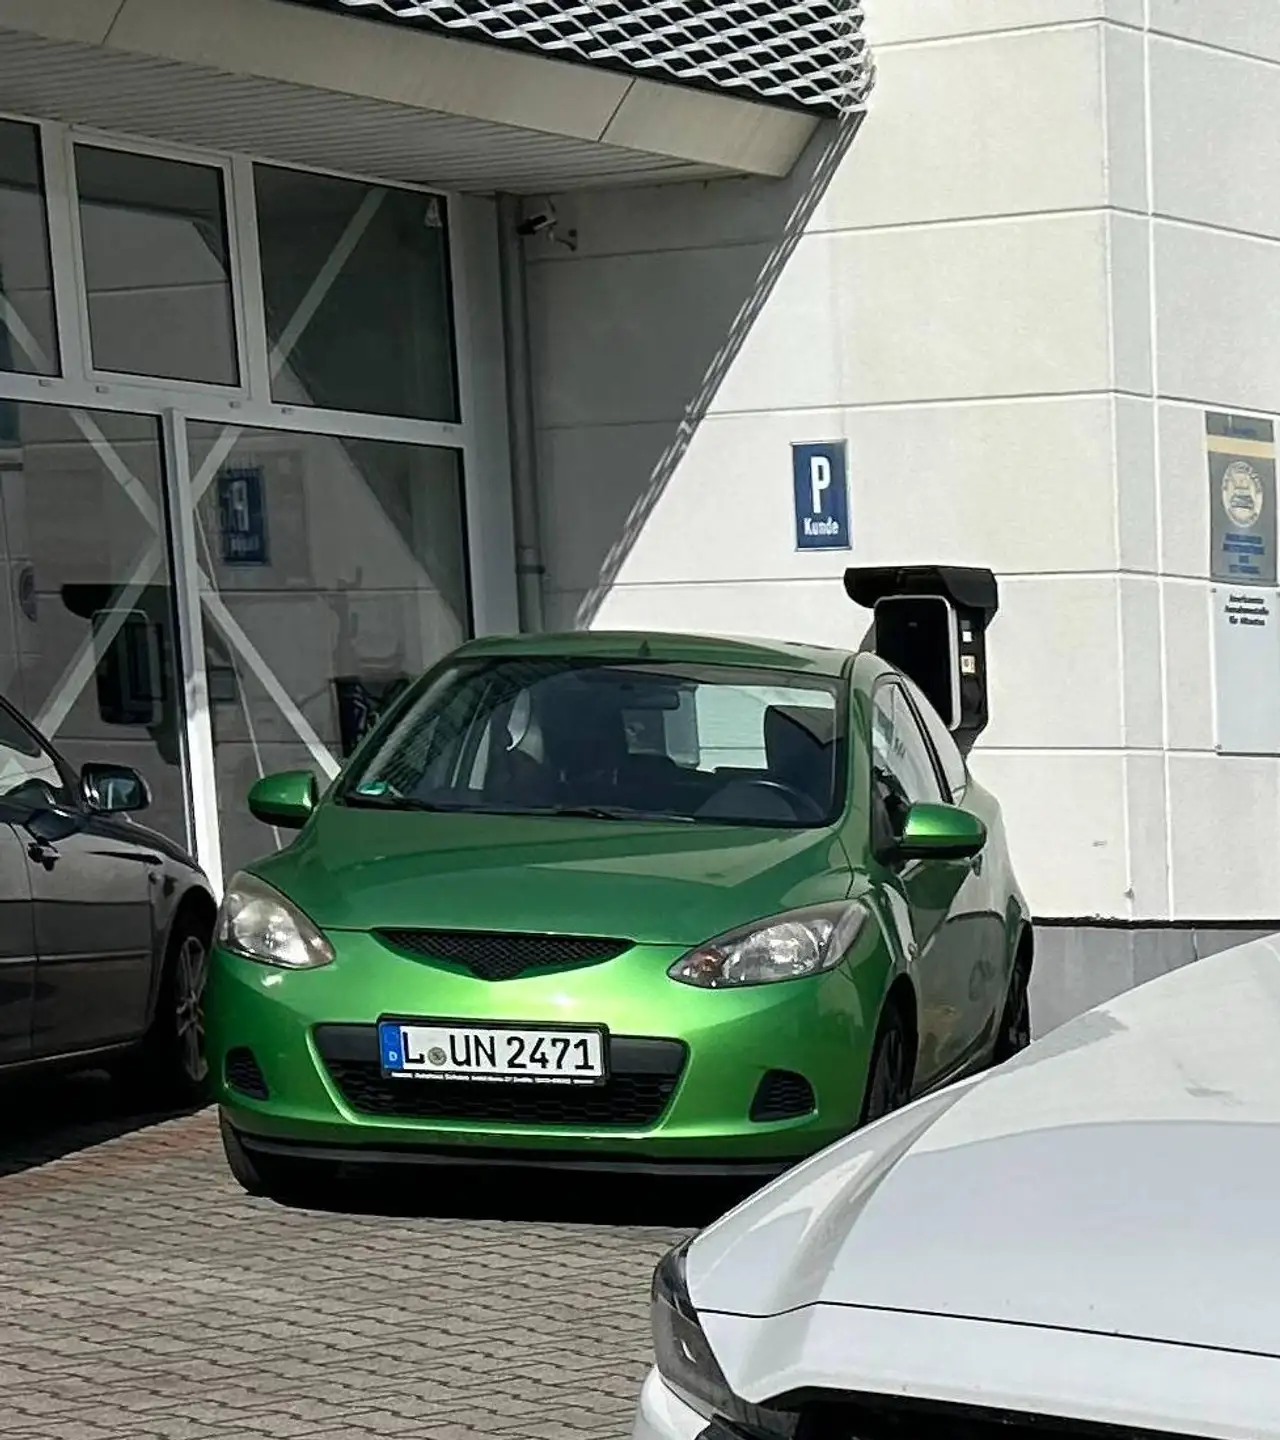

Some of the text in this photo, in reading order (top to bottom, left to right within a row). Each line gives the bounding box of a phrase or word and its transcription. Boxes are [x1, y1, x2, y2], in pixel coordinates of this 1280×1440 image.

[810, 456, 831, 513] P
[803, 516, 840, 536] Kunde
[402, 1031, 595, 1070] L UN 2471
